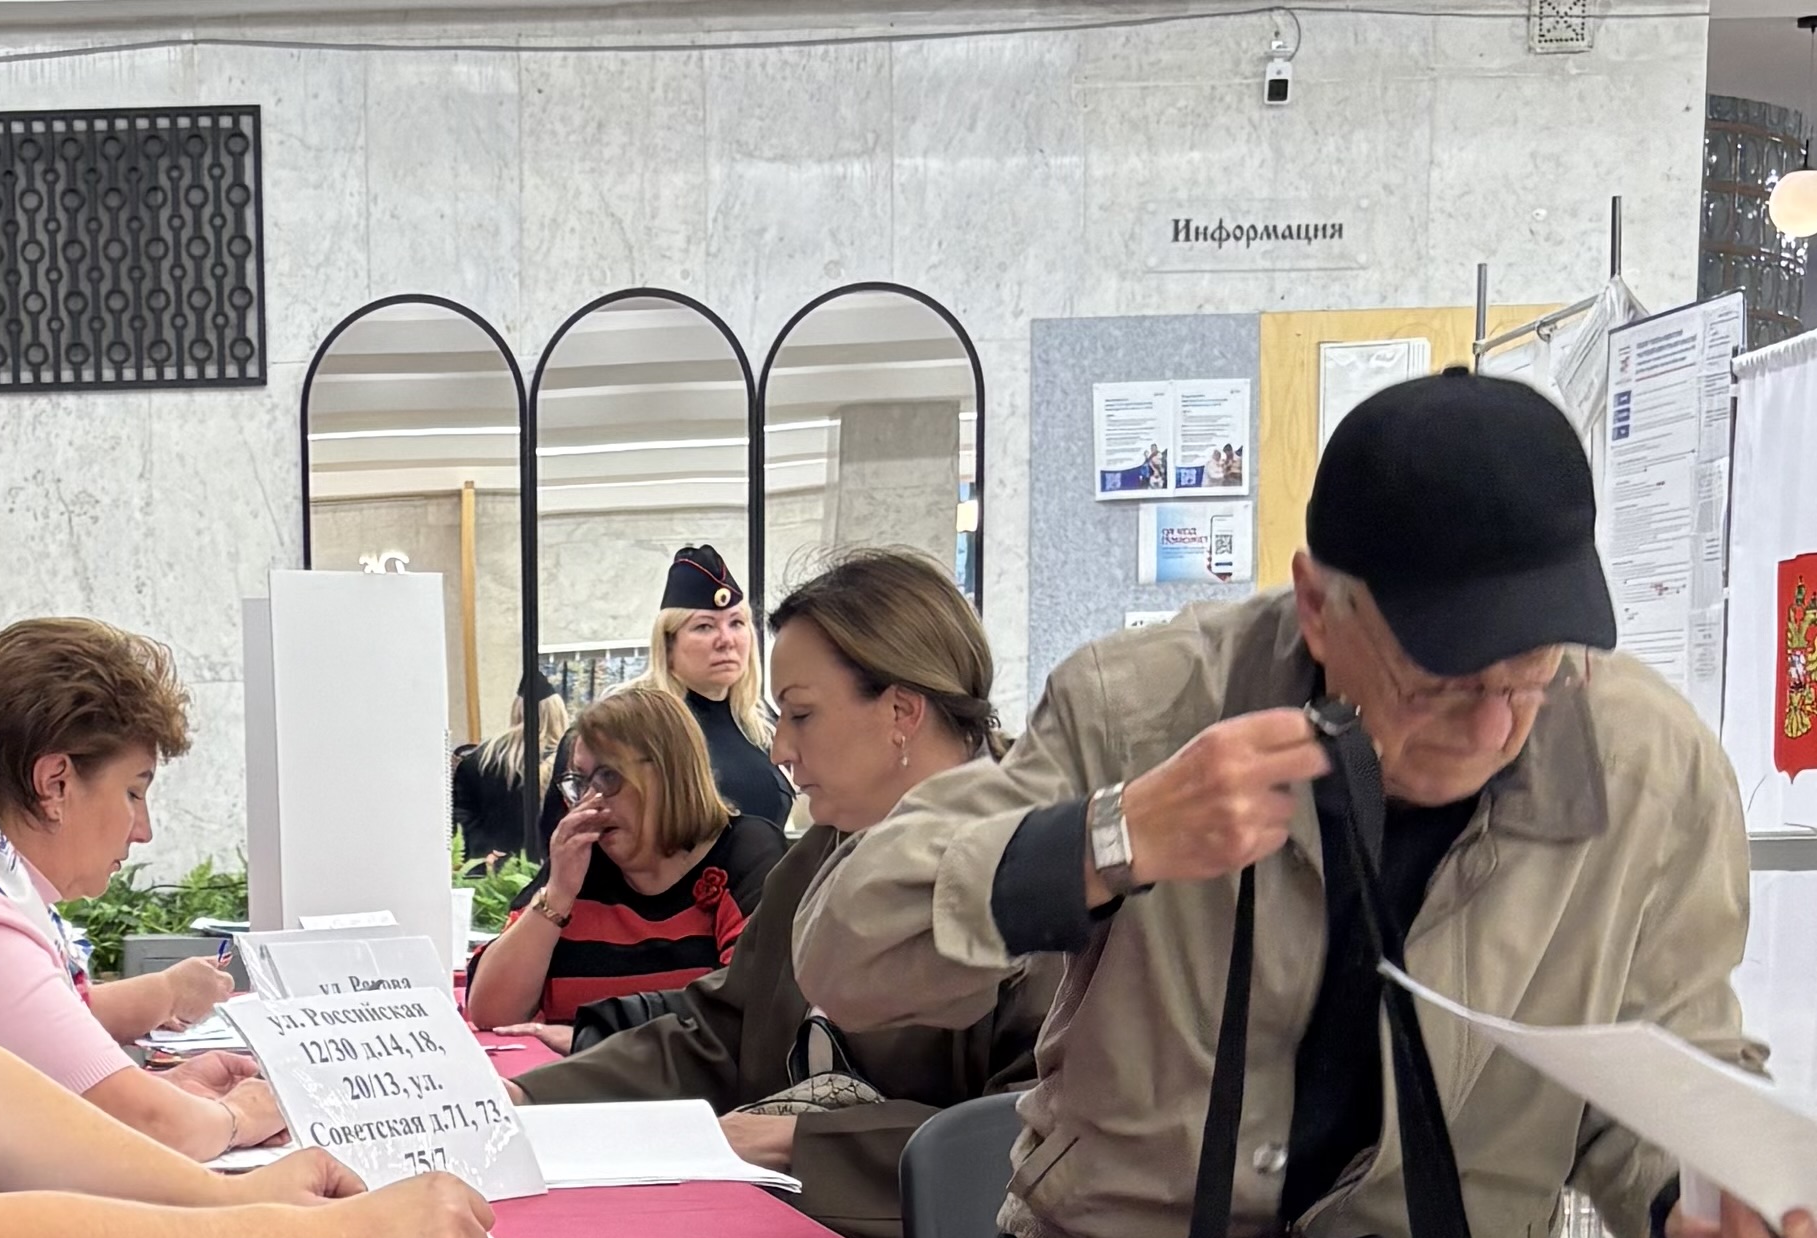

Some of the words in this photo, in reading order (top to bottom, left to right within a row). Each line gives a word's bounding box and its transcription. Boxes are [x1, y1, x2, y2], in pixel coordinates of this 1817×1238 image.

[1171, 217, 1343, 250] Информация
[267, 1014, 306, 1036] ул.
[300, 1002, 429, 1027] Российская
[300, 1038, 358, 1064] 12/30
[409, 1030, 446, 1056] 18,
[343, 1072, 410, 1101] 20/13,
[409, 1074, 443, 1099] ул.
[310, 1115, 426, 1147] Советская
[432, 1103, 479, 1132] д.71,
[475, 1099, 511, 1124] 73,
